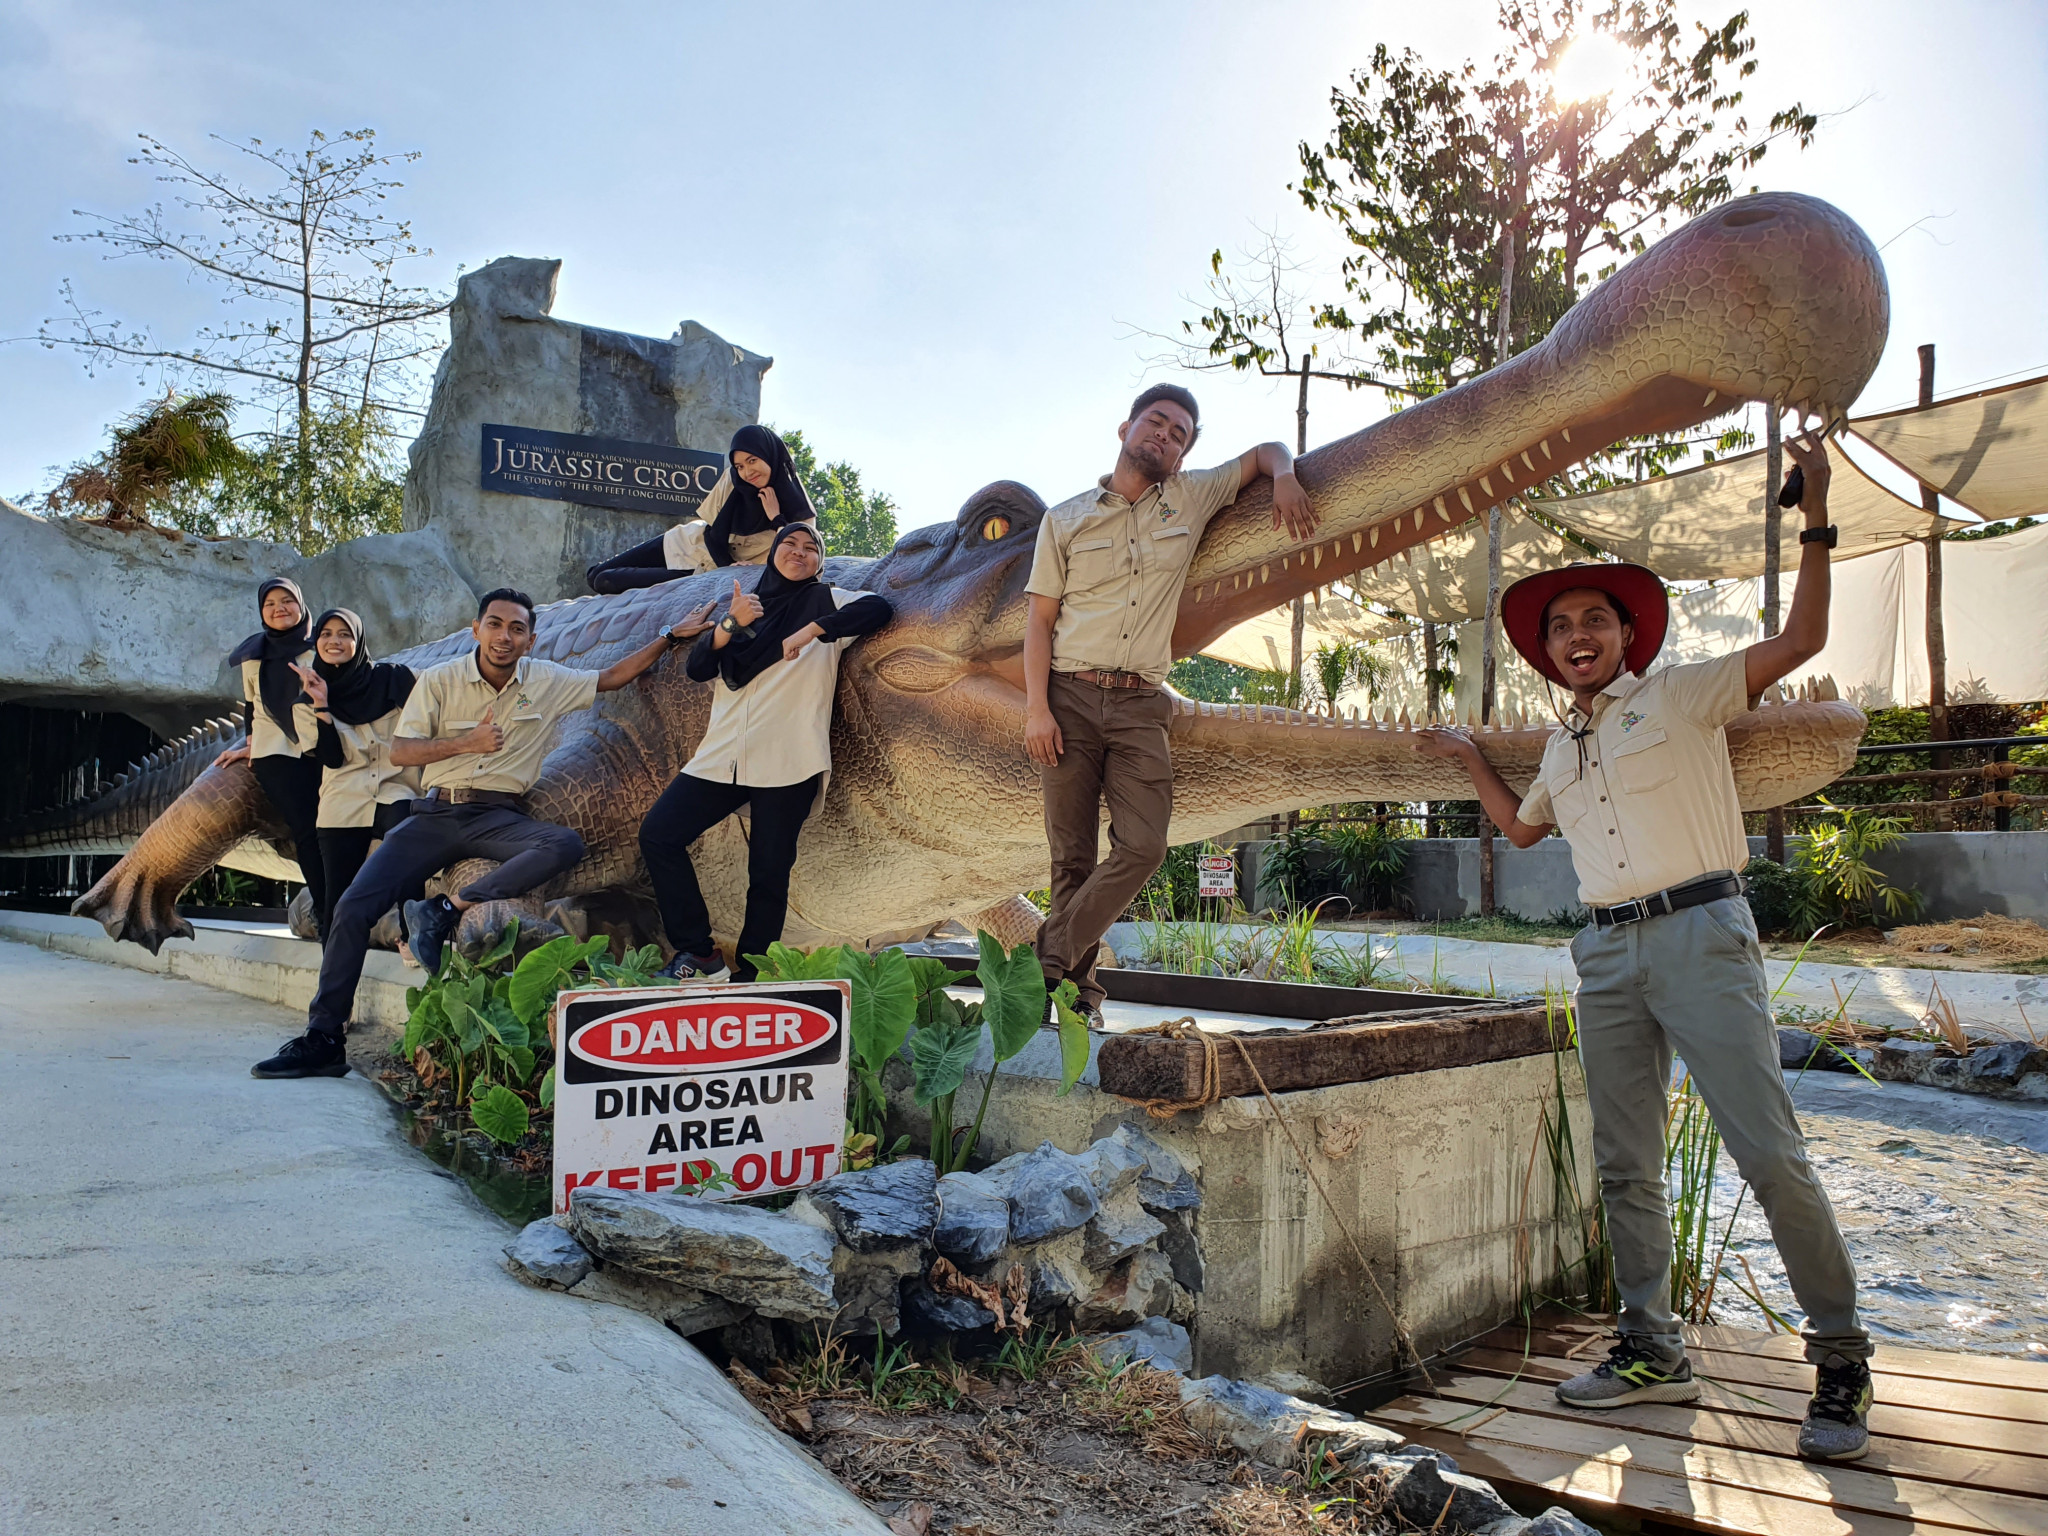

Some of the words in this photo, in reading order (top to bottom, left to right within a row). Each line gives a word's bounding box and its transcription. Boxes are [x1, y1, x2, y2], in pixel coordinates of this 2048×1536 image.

[515, 442, 529, 450] THE
[567, 449, 599, 460] LARGEST
[656, 460, 695, 472] DINOSAUR
[503, 472, 522, 481] THE
[524, 475, 552, 487] STORY
[554, 480, 567, 488] OF
[593, 484, 603, 493] 50
[605, 486, 626, 496] FEET
[628, 488, 654, 499] LONG
[1200, 887, 1218, 895] KEEP
[1219, 887, 1233, 896] OUT
[610, 1012, 804, 1057] DANGER
[595, 1072, 814, 1120] DINOSAUR
[647, 1114, 764, 1155] AREA
[732, 1144, 835, 1192] OUT
